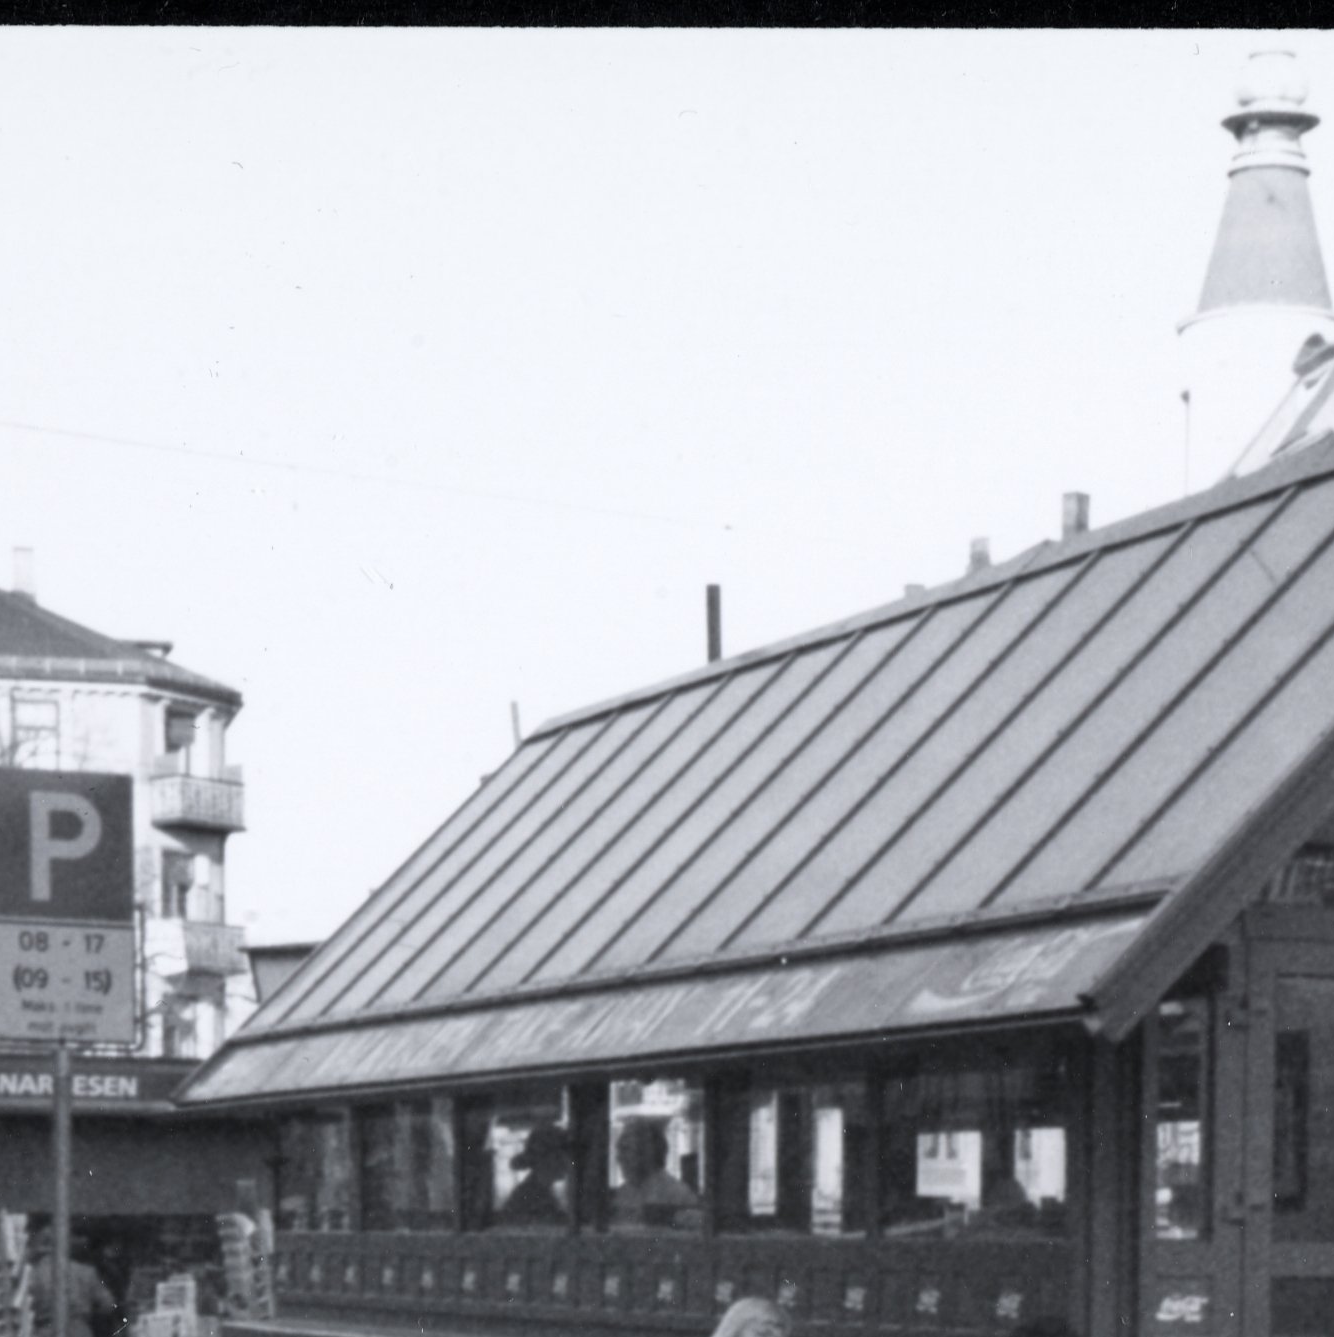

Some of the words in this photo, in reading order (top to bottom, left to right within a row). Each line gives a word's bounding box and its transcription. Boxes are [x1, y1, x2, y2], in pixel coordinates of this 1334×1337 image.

[30, 790, 102, 901] P
[18, 931, 49, 951] 08
[84, 934, 105, 953] 17
[13, 966, 48, 992] (09
[84, 970, 112, 995] 15)
